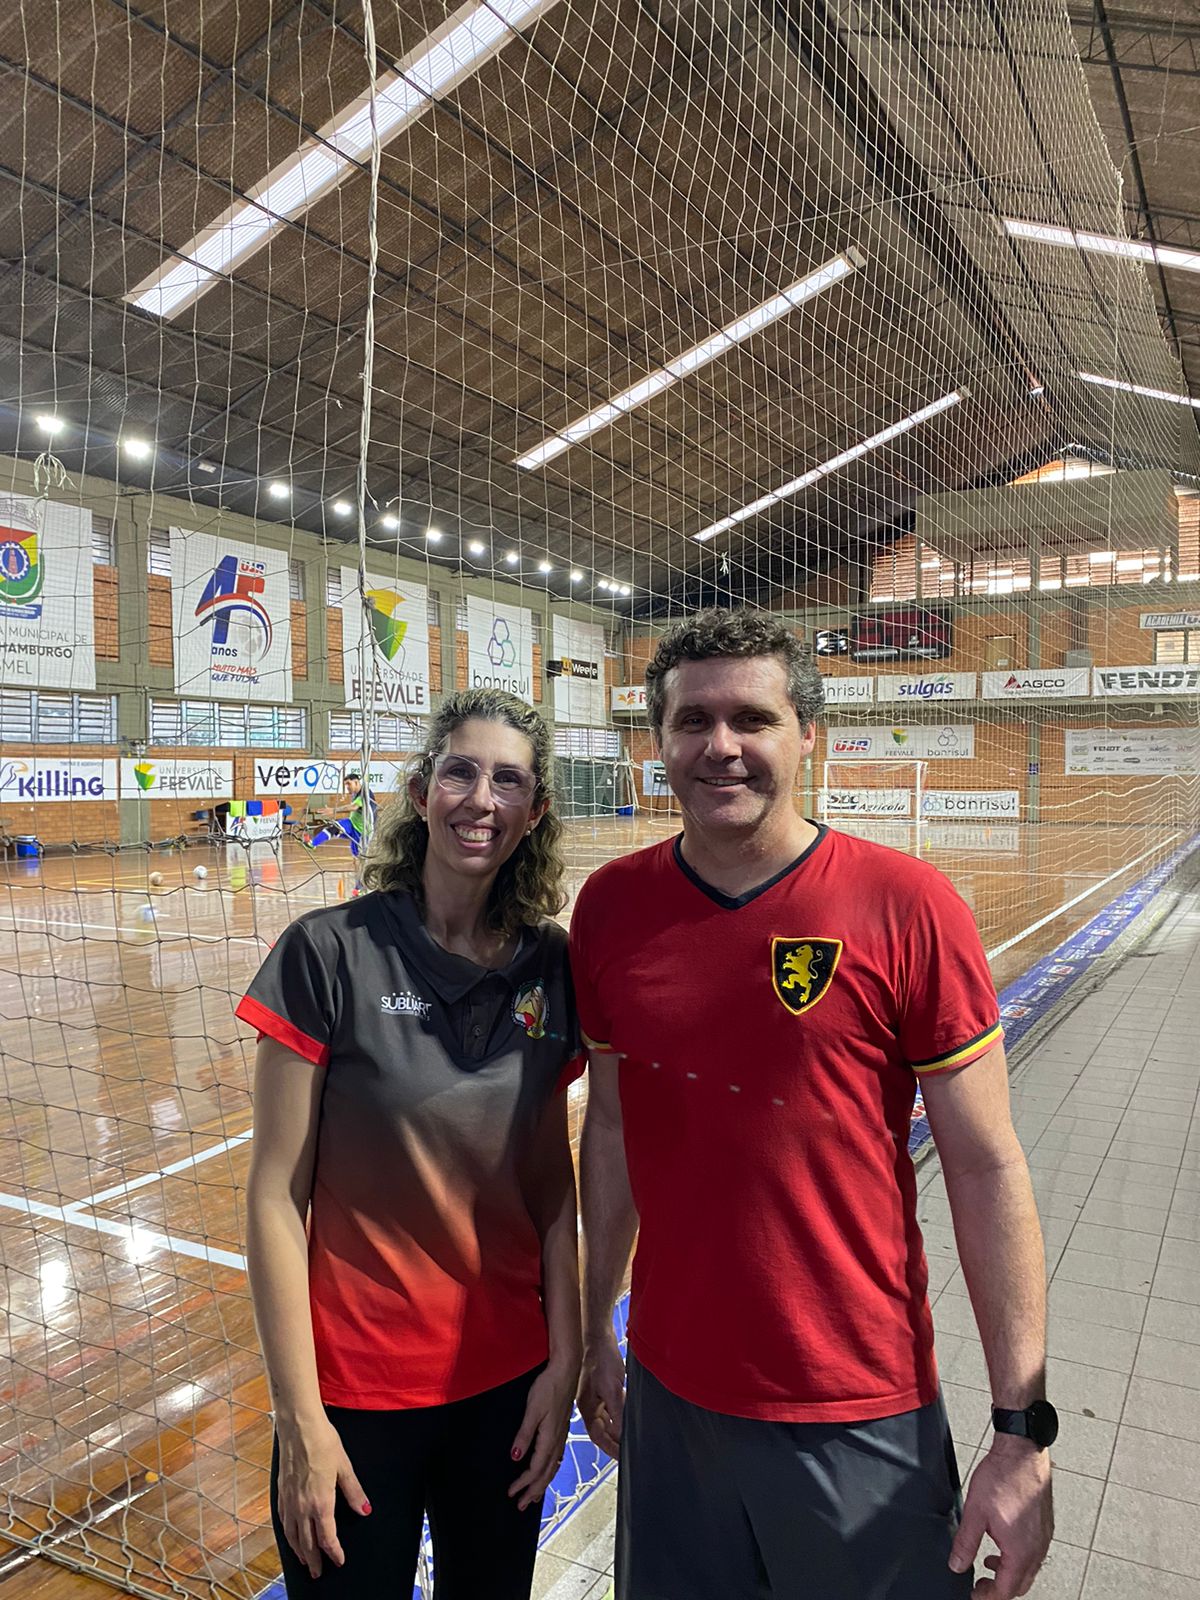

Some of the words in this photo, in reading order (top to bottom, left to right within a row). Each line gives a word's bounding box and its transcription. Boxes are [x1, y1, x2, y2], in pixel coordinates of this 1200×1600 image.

[9, 626, 69, 642] MUNICIPAL
[75, 634, 87, 644] DE
[211, 647, 238, 657] anos
[0, 659, 32, 676] MEL
[212, 664, 236, 673] MUITO
[237, 665, 257, 676] MAIS
[351, 664, 423, 682] UIRSIDADE
[211, 673, 229, 682] QUE
[473, 669, 529, 695] banrisul
[1022, 679, 1065, 688] AGCO
[1100, 671, 1200, 689] FENDT
[822, 683, 870, 698] nrisul
[928, 748, 968, 756] banrisul
[160, 776, 222, 790] FEEVALE
[258, 765, 318, 787] vero
[944, 798, 1015, 811] banrisul
